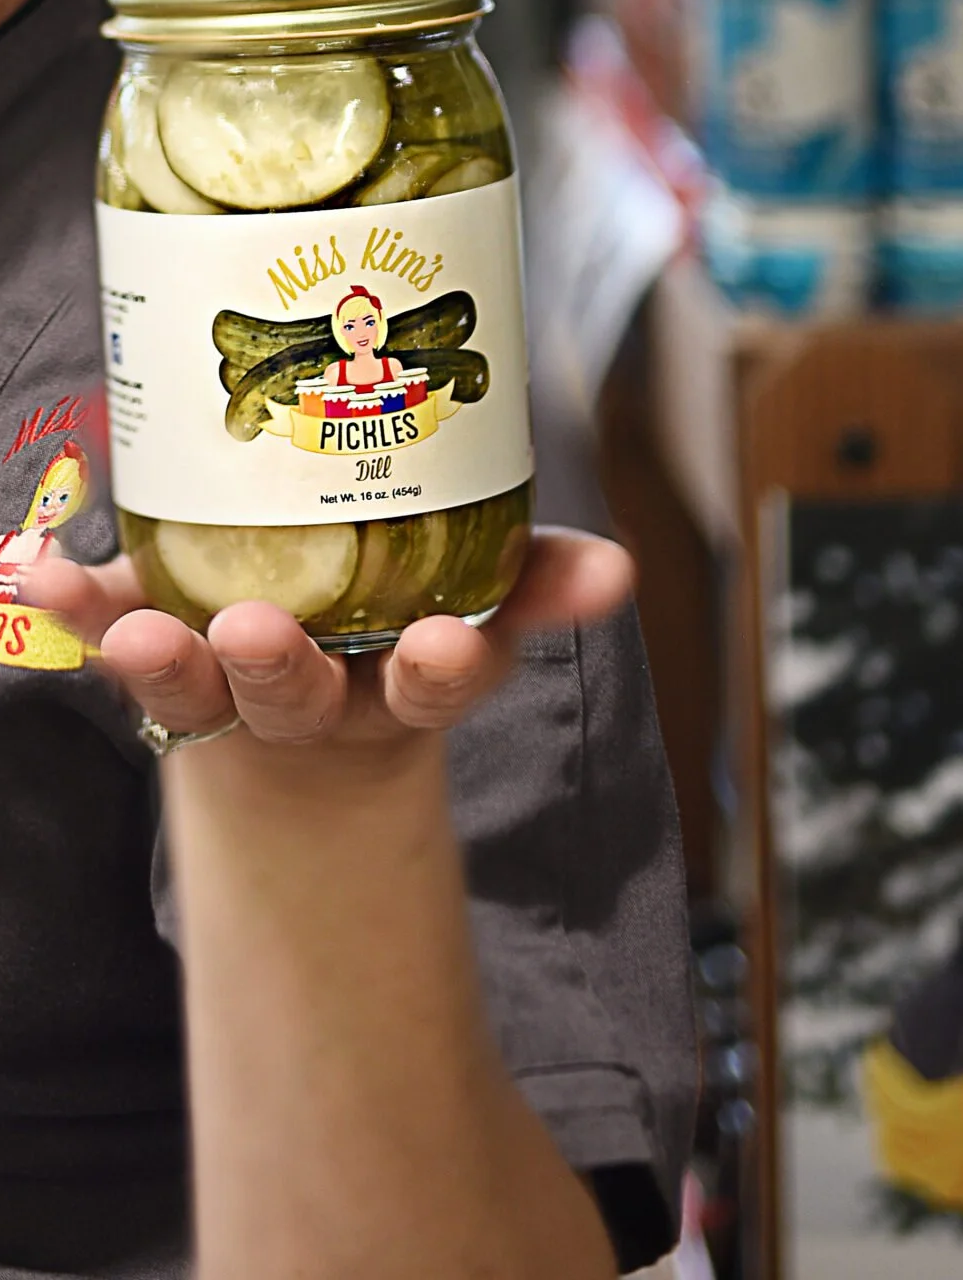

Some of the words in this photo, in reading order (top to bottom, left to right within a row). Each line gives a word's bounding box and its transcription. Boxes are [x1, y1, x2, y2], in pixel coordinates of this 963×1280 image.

[267, 235, 346, 310] Miss
[360, 227, 444, 292] Kim's
[320, 412, 419, 451] PICKLES
[355, 455, 392, 482] Dill
[320, 495, 338, 504] Net
[339, 493, 357, 503] Wt.
[360, 491, 372, 501] 16
[374, 492, 389, 500] oz.
[392, 484, 422, 499] (454g)
